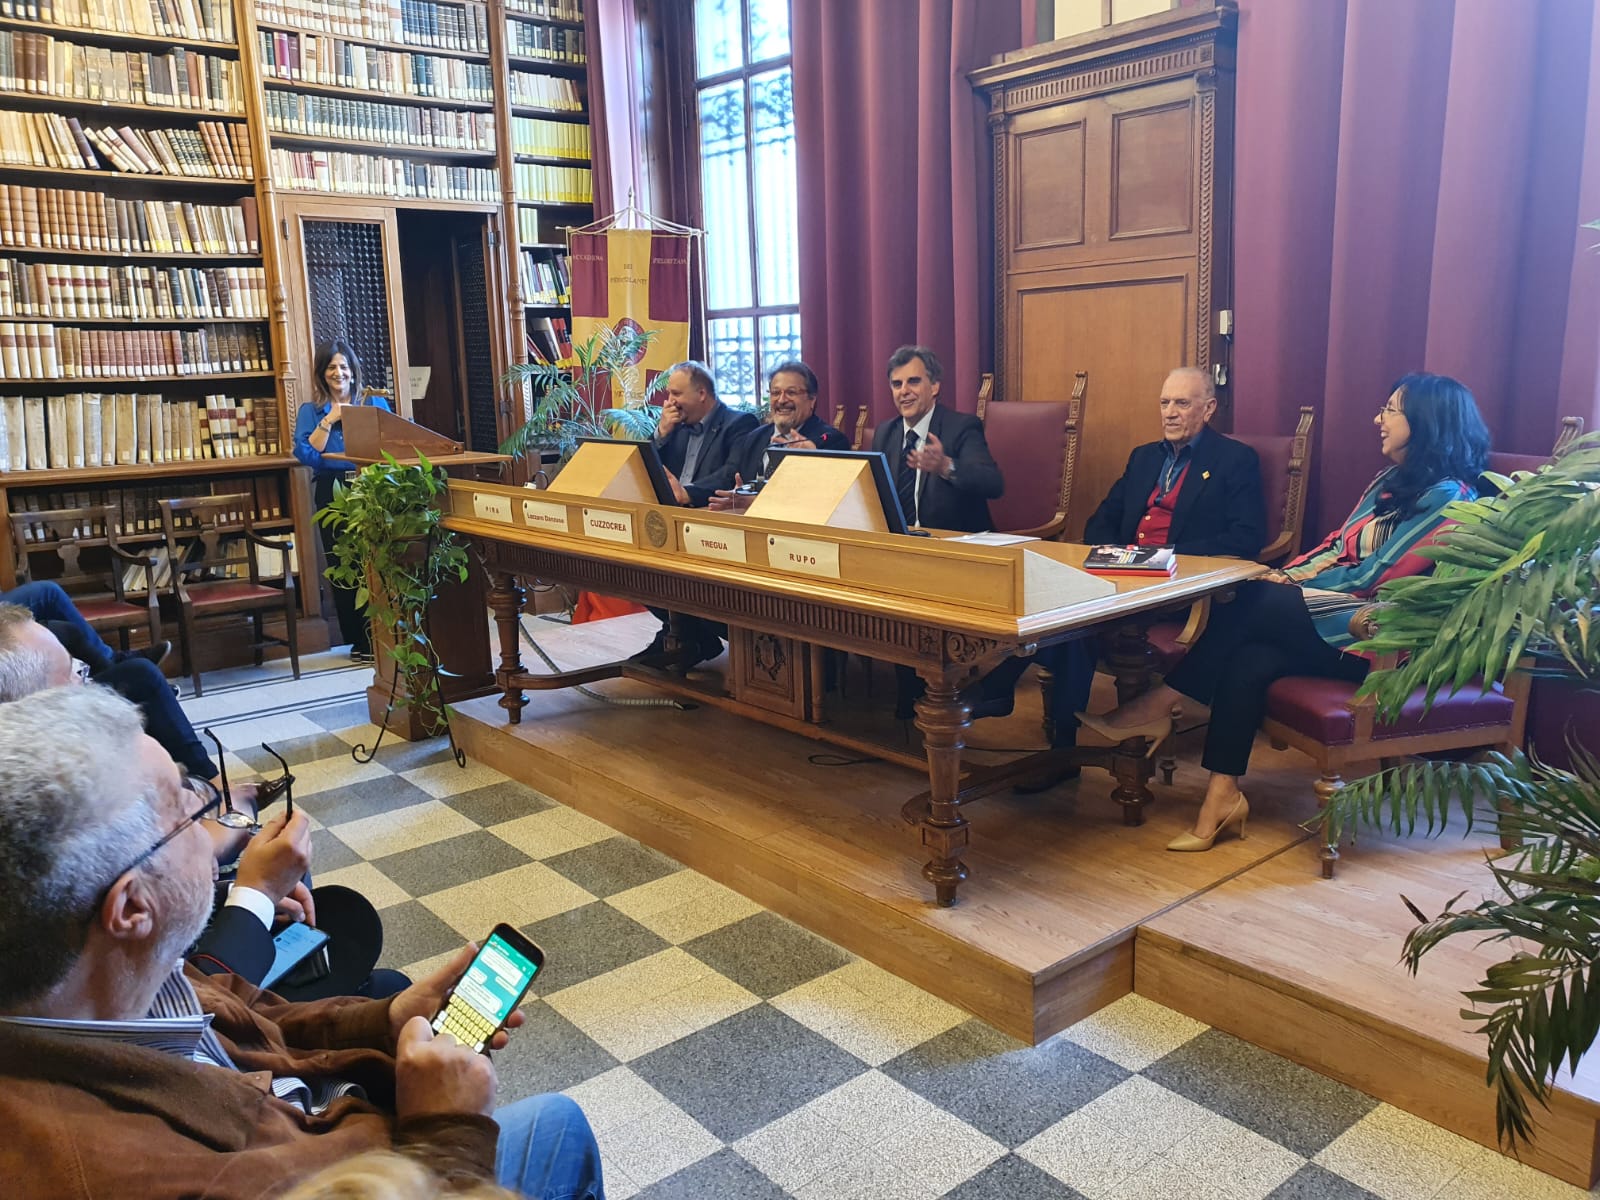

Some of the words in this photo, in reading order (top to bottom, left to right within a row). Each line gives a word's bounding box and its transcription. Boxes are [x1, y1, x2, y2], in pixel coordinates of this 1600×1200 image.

[590, 519, 627, 532] CUZZOCREA
[701, 539, 728, 551] TREGUA
[789, 553, 816, 565] RUPO
